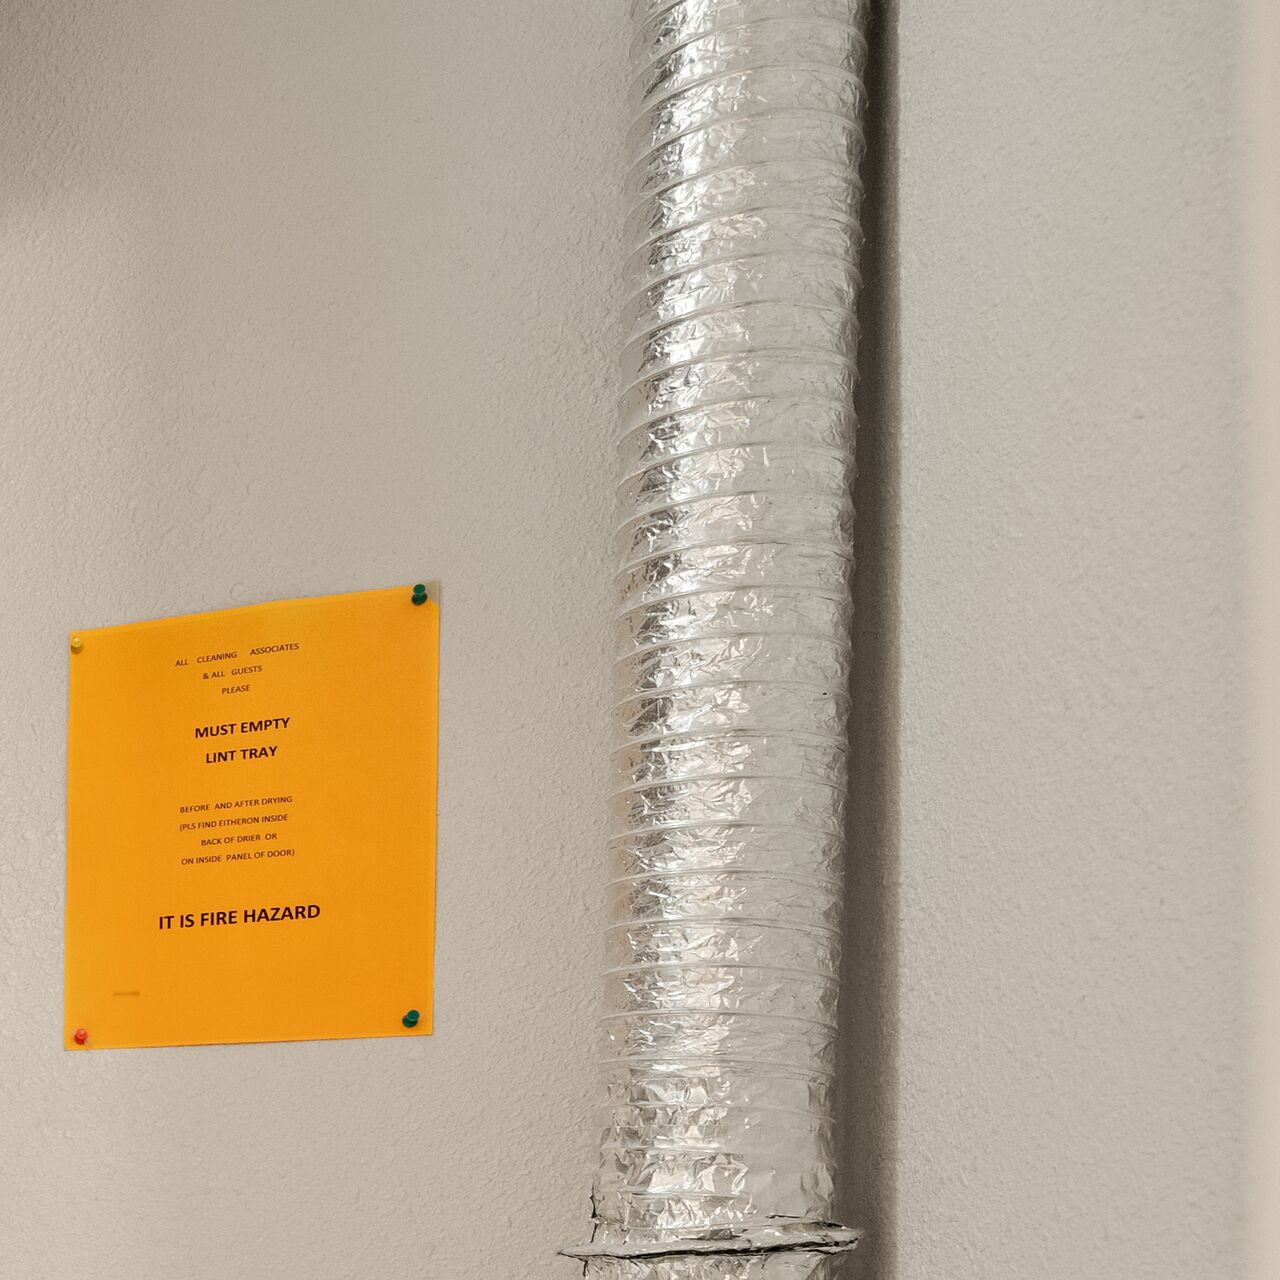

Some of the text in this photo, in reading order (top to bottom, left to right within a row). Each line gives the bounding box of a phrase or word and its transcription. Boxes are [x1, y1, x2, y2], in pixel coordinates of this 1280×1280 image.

[175, 643, 299, 667] ALL CLEANING ASSOCIATES
[231, 665, 263, 676] GUESTS
[221, 684, 251, 694] PLEASE
[194, 717, 291, 739] MUST EMPTY
[205, 746, 278, 764] LINT TRAY
[179, 796, 293, 813] BEFORE AND AFTER DRYING
[179, 822, 197, 832] (PLS
[198, 820, 217, 829] FIND
[261, 813, 289, 823] INSIDE
[200, 832, 278, 846] BACK OF DRIER OR
[181, 848, 295, 866] ON INSIDE PANEL OF DOOR)
[159, 904, 321, 930] IT IS FIRE HAZARD
